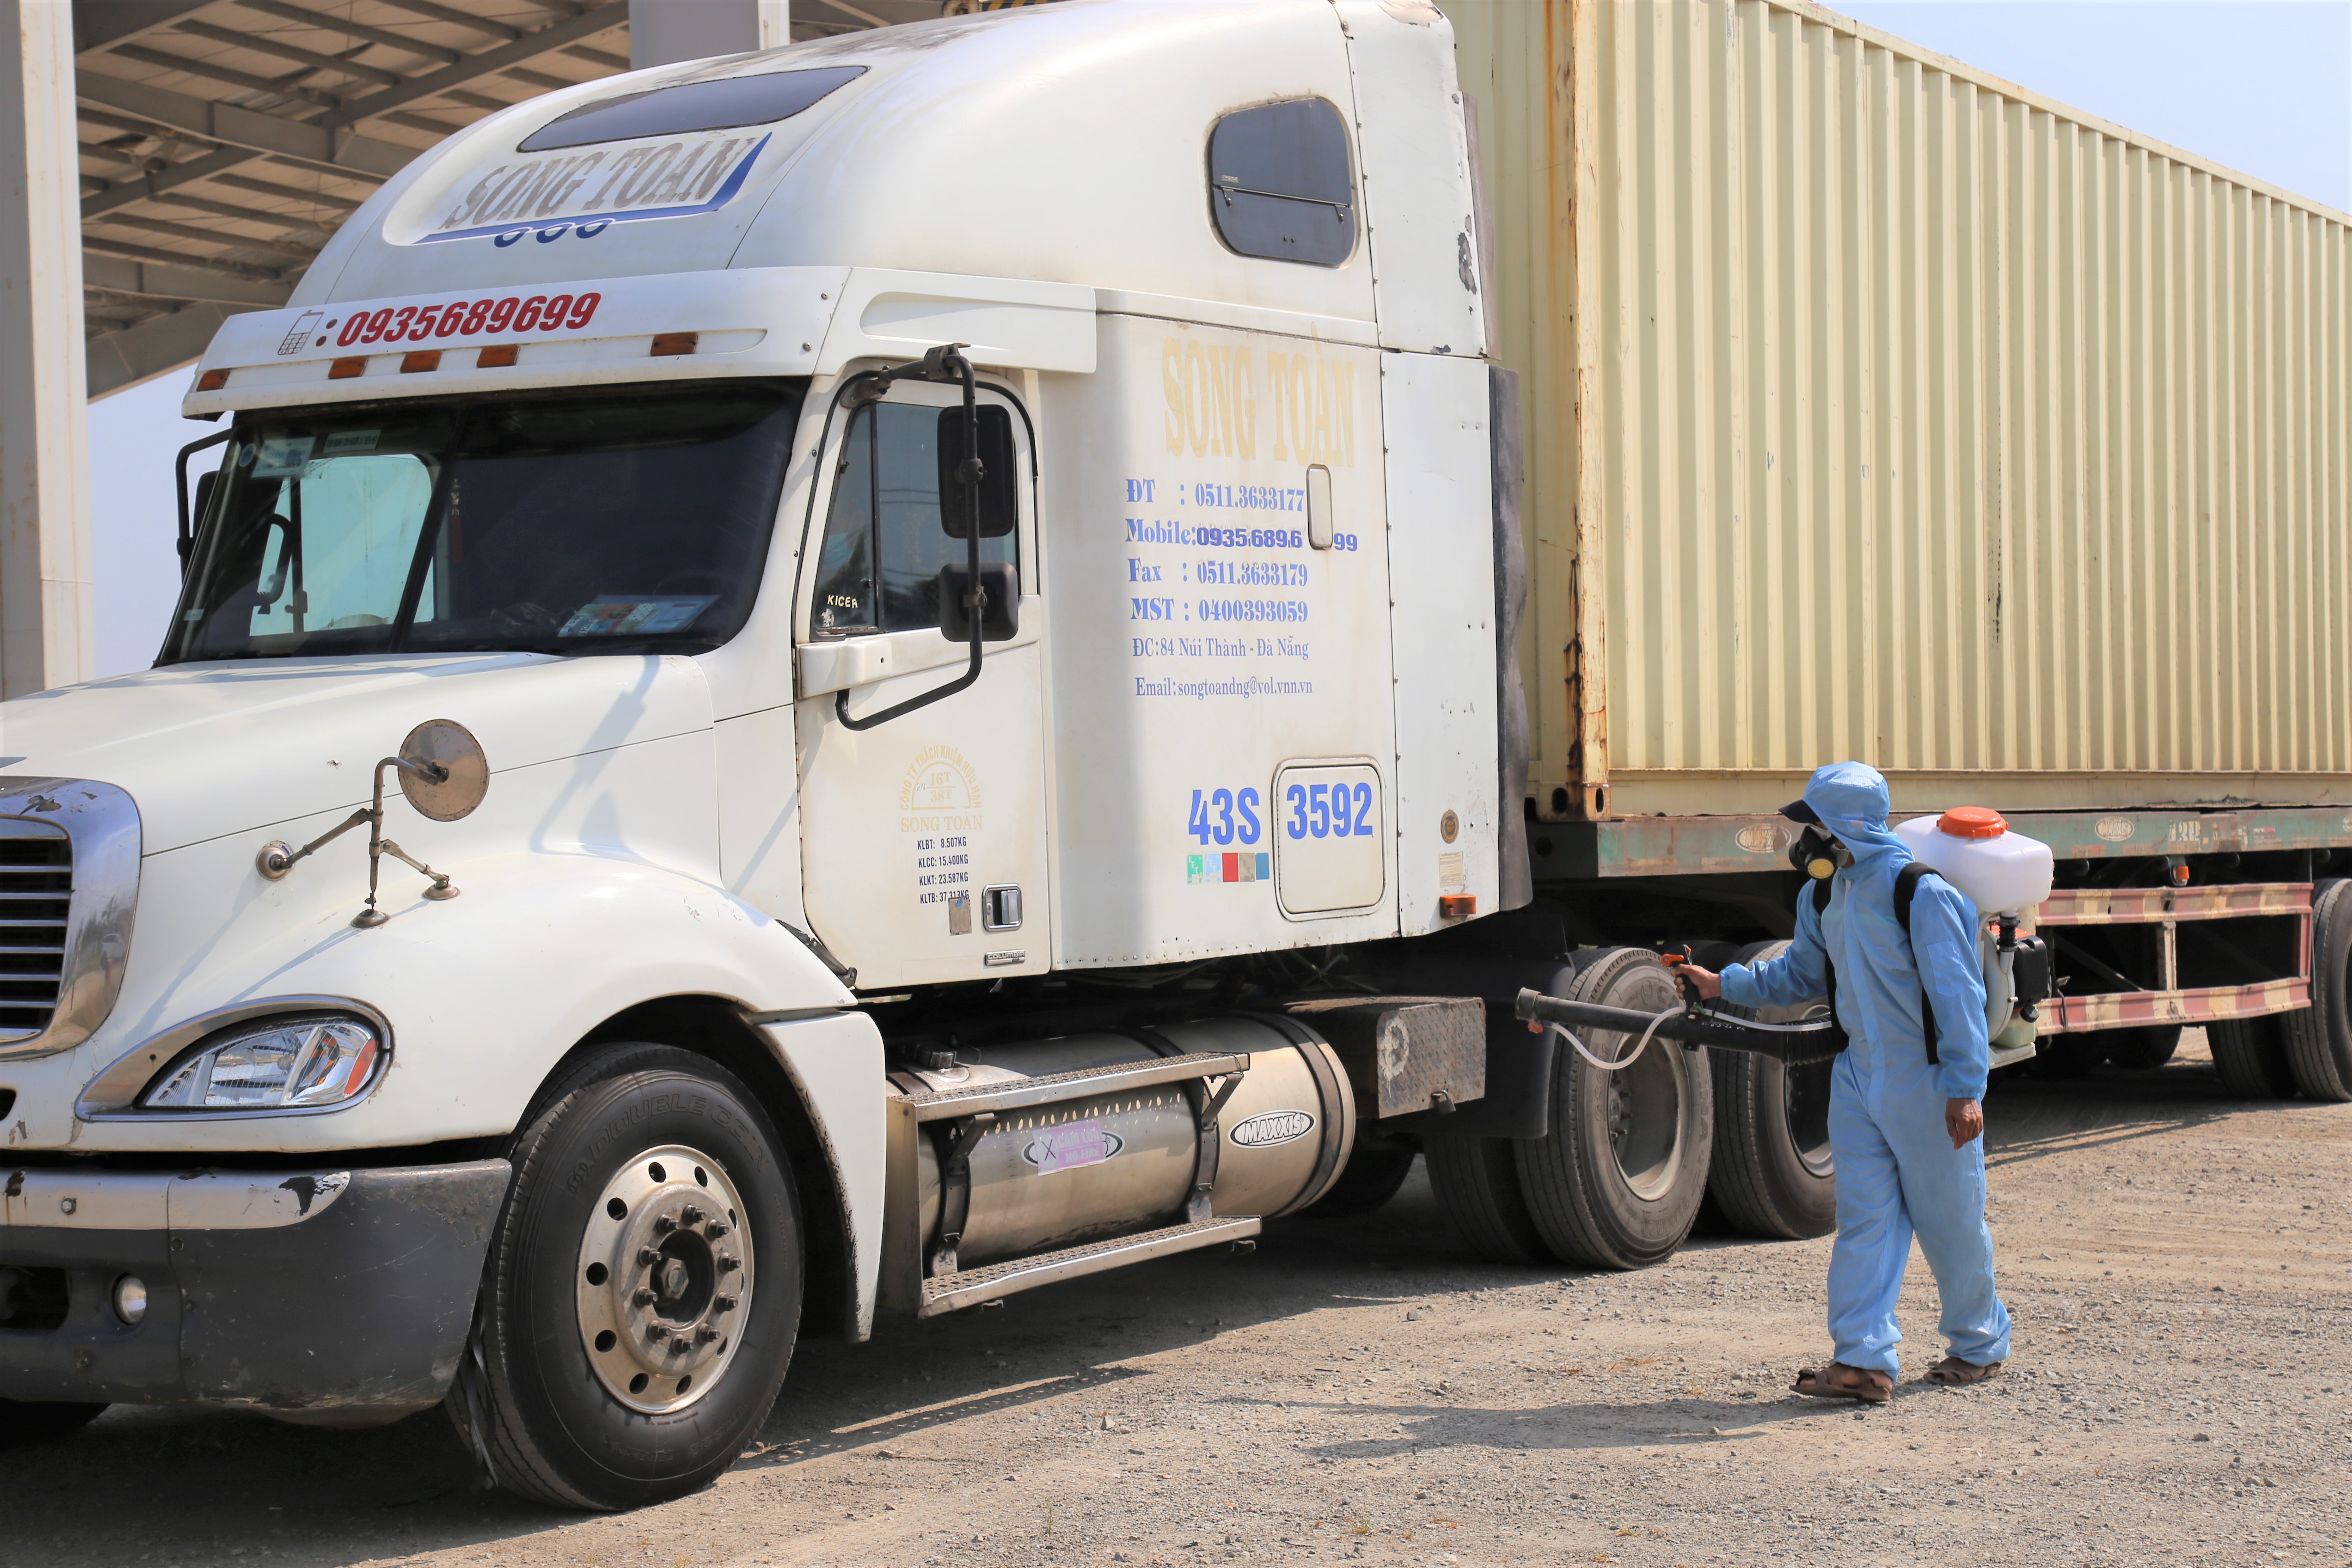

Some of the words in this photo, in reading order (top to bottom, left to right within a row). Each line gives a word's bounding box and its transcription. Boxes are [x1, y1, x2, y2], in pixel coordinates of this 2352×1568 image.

[438, 150, 611, 230] SONG
[337, 293, 601, 346] 0935689699
[1163, 337, 1256, 461] SONG
[1267, 321, 1355, 467] TOÀN
[1126, 478, 1155, 503] ĐT
[1195, 483, 1305, 512] 0511.3633177
[1127, 557, 1162, 582] Fax
[1197, 559, 1308, 587] 0511.3633179
[1130, 597, 1175, 621] MST
[1199, 599, 1308, 622] 0400393059
[1179, 637, 1202, 657] Núi
[1205, 637, 1247, 657] Thành
[1256, 638, 1274, 657] Đà
[1277, 635, 1309, 660] Nẵng
[906, 763, 917, 780] TY
[930, 771, 951, 786] 16T
[930, 789, 952, 803] 38T
[900, 816, 940, 833] SONG
[1188, 787, 1261, 845] 43S
[1286, 782, 1373, 839] 3592
[917, 839, 935, 850] KLBT:
[940, 836, 967, 848] 8.507KG
[918, 857, 937, 868] KLCC:
[939, 854, 968, 866] 15.400KG
[919, 875, 937, 886] KLKT:
[939, 872, 968, 884] 23.587KG
[920, 892, 938, 904] KLTB:
[589, 1092, 707, 1156] DOUBLE
[711, 1104, 770, 1173] COIN
[1243, 1112, 1302, 1145] MAXXIS
[1066, 1151, 1078, 1163] NO
[1081, 1148, 1100, 1159] FIRE
